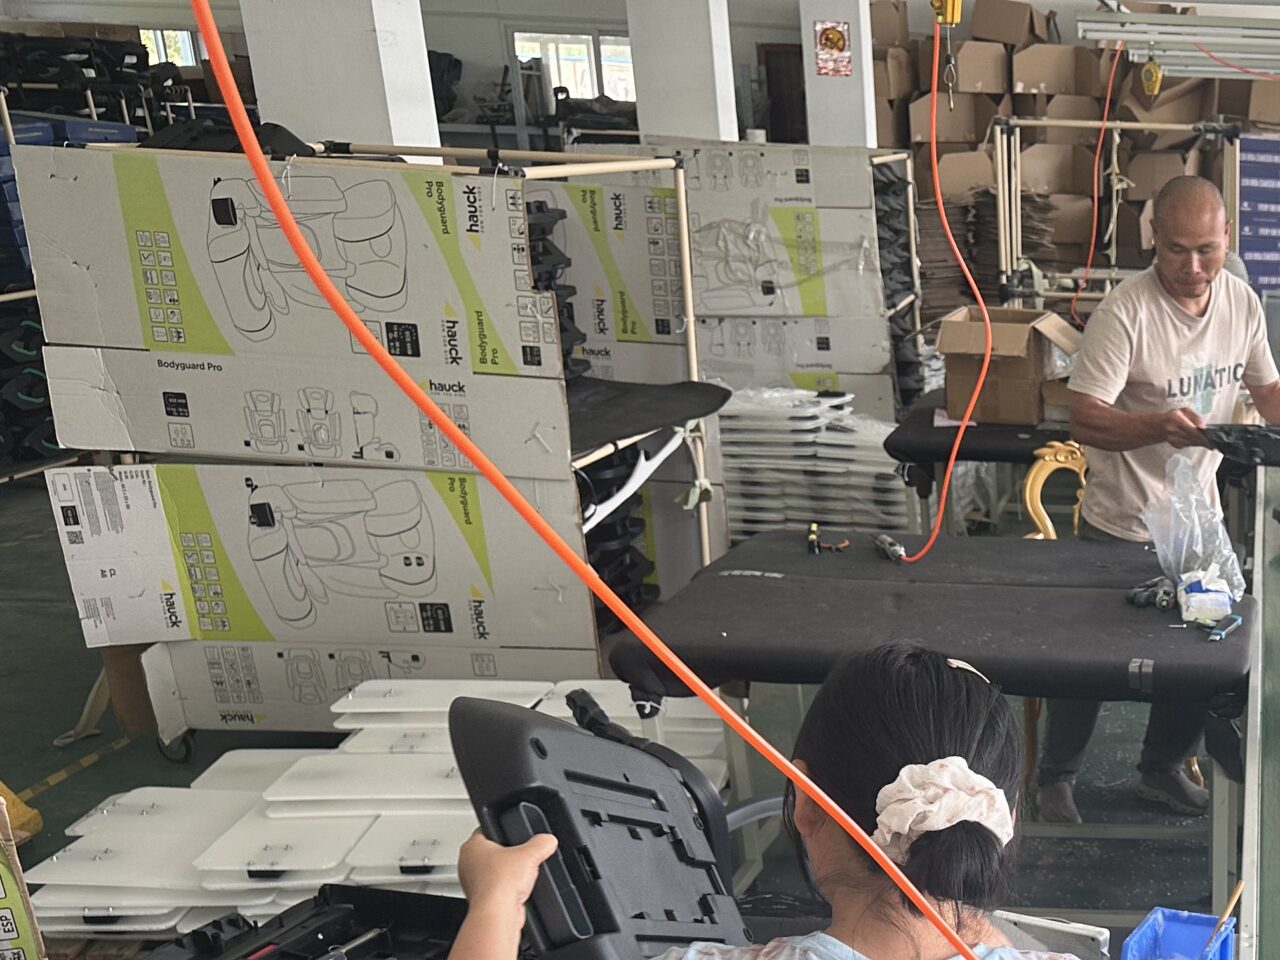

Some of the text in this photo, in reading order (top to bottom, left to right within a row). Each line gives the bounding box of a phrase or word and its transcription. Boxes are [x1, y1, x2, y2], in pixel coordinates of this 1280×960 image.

[425, 180, 434, 198] Pro
[435, 181, 450, 235] Bodyguard
[463, 184, 480, 233] hauck
[611, 192, 624, 231] hauck
[597, 299, 608, 335] hauck
[446, 319, 463, 366] hauck
[475, 310, 487, 364] Bodyguard
[582, 346, 611, 357] hauck
[157, 359, 223, 371] Bodyguard Pro
[491, 348, 499, 366] Pro
[429, 379, 466, 393] hauck
[1167, 363, 1243, 398] LUNATIC
[448, 477, 456, 493] Pro
[458, 477, 473, 526] Bodyguard
[163, 592, 182, 628] hauck
[472, 600, 490, 640] hauck
[219, 713, 255, 724] hauck
[0, 915, 15, 933] ESP
